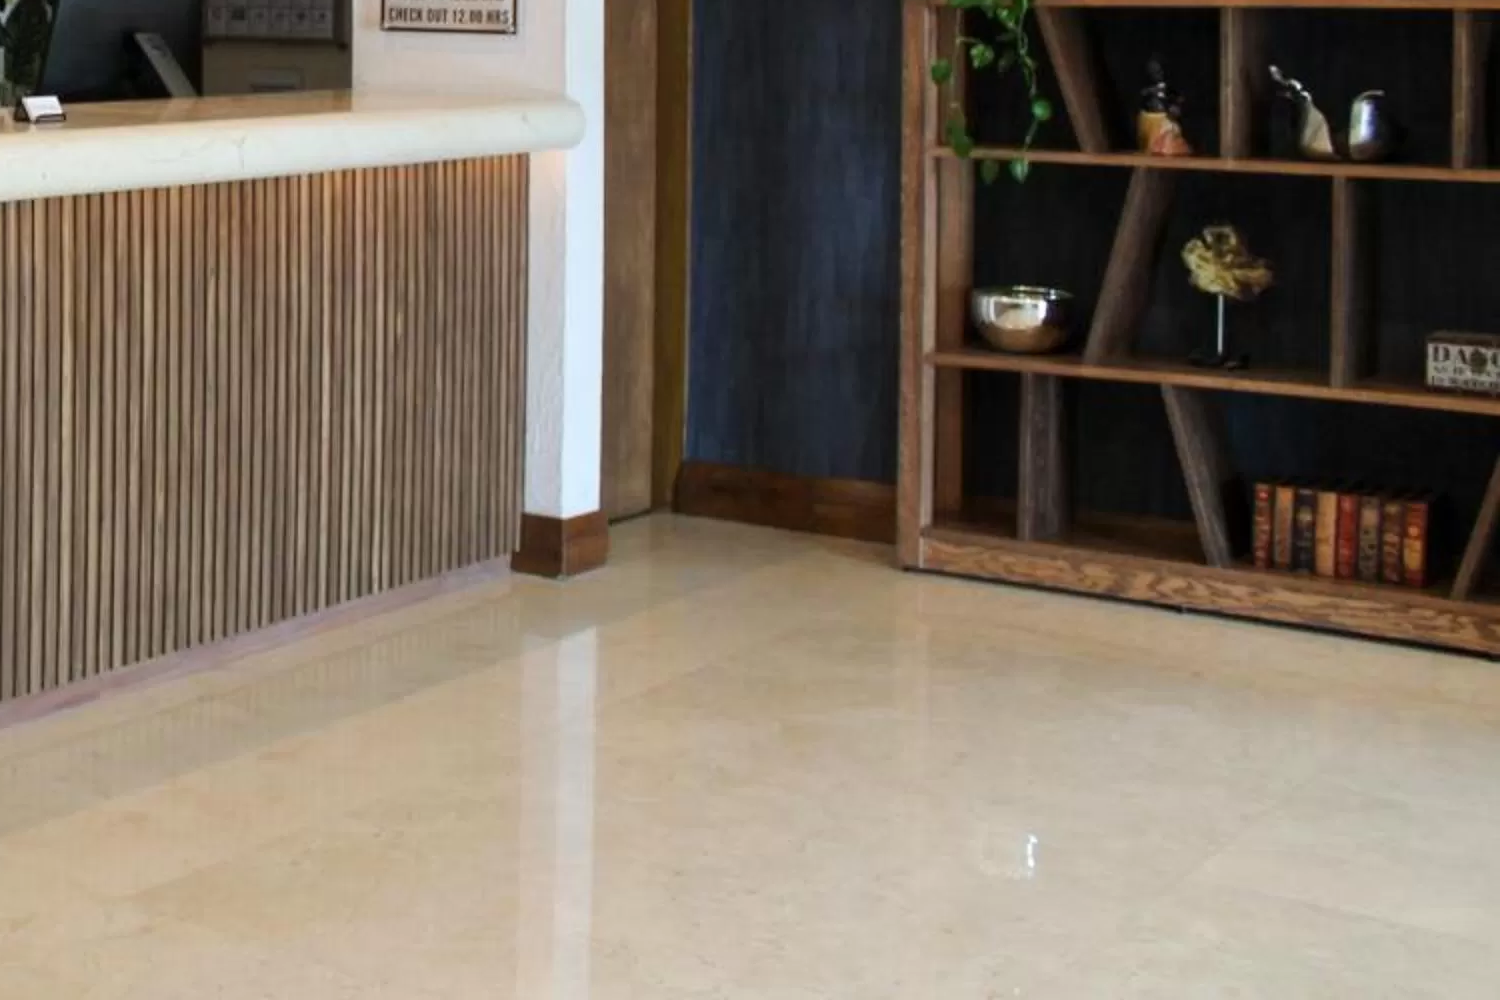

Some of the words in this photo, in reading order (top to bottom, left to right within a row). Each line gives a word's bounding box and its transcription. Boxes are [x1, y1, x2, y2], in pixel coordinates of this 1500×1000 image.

[387, 7, 423, 22] CHECK
[426, 8, 448, 23] OUT
[485, 10, 509, 25] HRS
